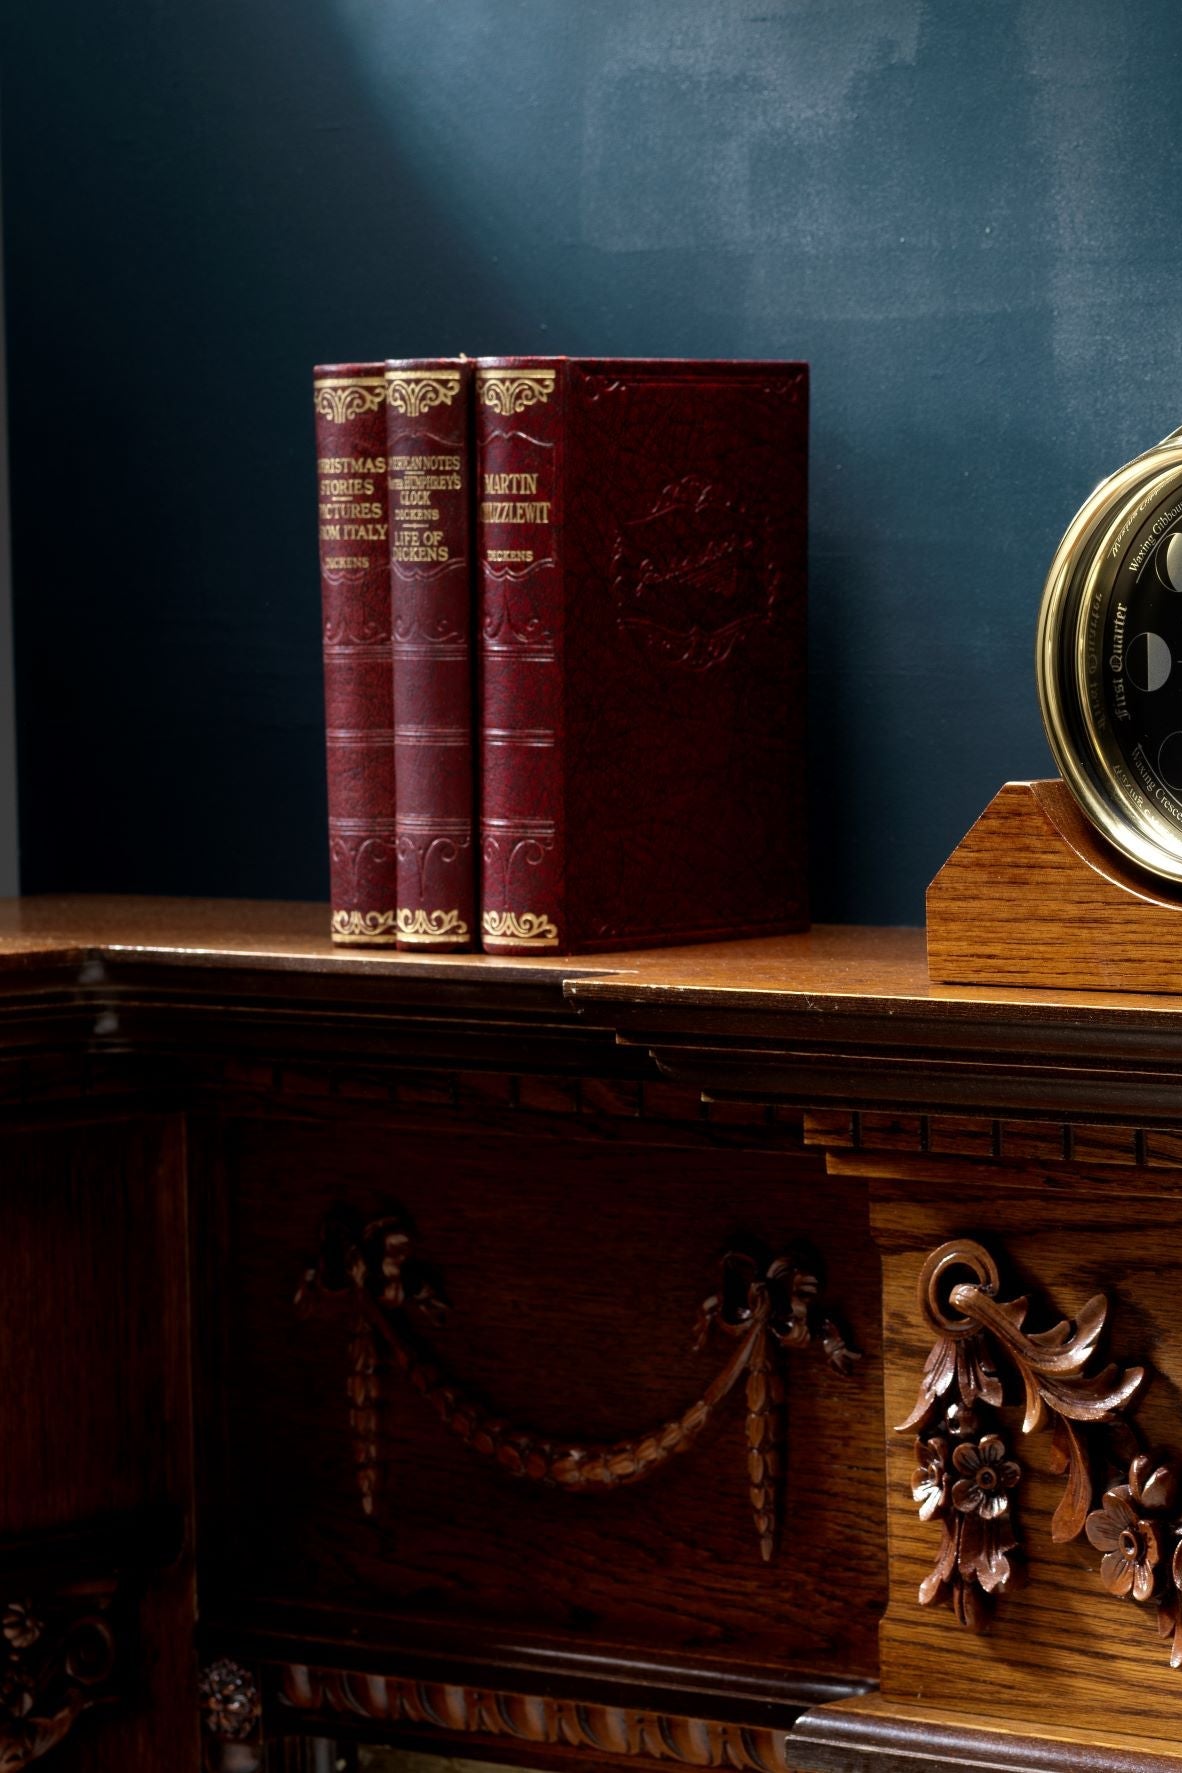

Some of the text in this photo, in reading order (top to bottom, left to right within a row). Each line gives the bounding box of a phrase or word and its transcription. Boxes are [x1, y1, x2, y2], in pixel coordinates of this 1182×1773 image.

[423, 455, 461, 471] NOTES
[320, 479, 375, 496] STORIES
[484, 473, 539, 495] MARTIN
[400, 490, 432, 506] CLOCK
[394, 508, 440, 521] DICKENS
[343, 524, 389, 541] ITALY
[394, 530, 444, 546] LIFE OF
[391, 546, 449, 562] DICKENS
[486, 549, 535, 562] DICKENS
[1128, 535, 1157, 573] Waxing
[325, 556, 370, 570] DICKENS
[1108, 602, 1131, 721] First Quarter
[1131, 746, 1156, 792] Waxing
